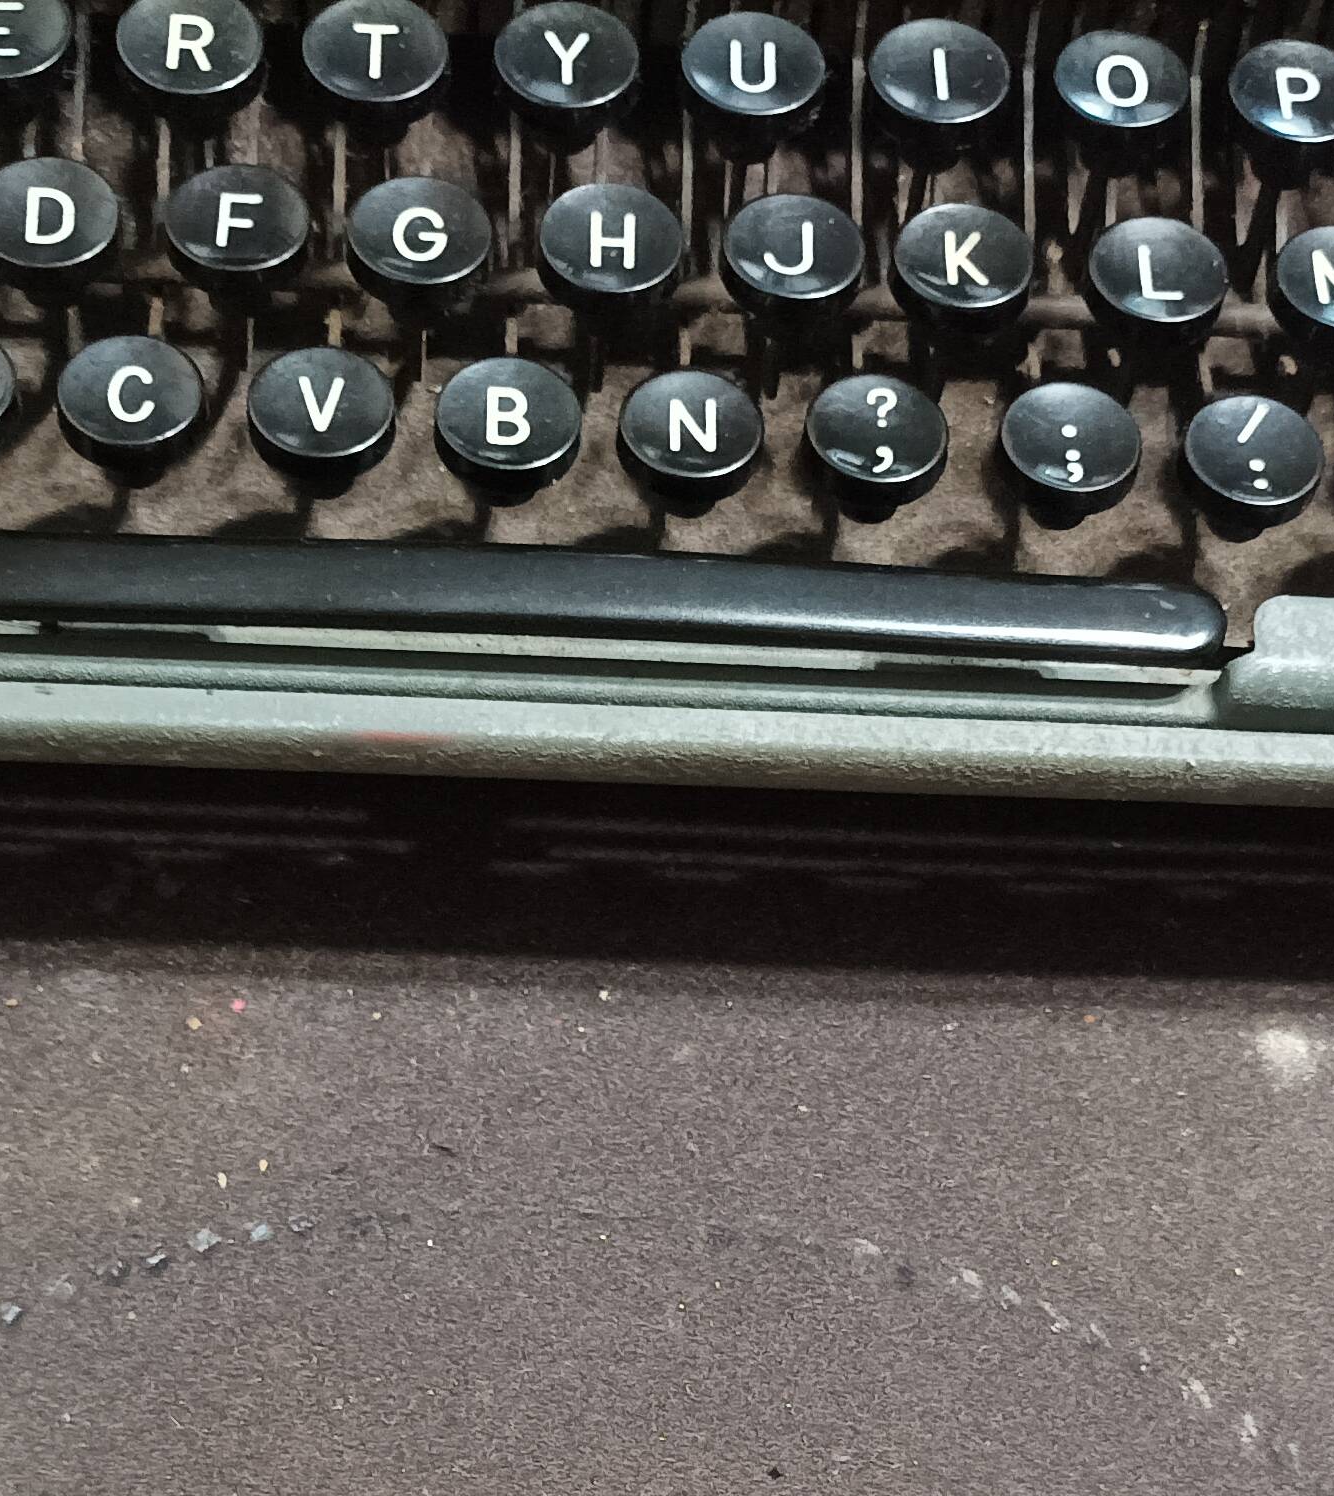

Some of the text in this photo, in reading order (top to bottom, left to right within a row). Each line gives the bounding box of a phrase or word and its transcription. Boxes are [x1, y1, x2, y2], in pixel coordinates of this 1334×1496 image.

[165, 13, 215, 72] R
[352, 22, 400, 80] T
[544, 30, 590, 85] Y
[730, 39, 777, 94] U
[933, 47, 949, 101] I
[1095, 54, 1149, 108] O
[1274, 67, 1322, 119] P
[24, 186, 76, 245] D
[215, 192, 263, 247] F
[392, 206, 448, 262] G
[589, 209, 636, 270] H
[763, 221, 814, 276] J
[944, 230, 989, 286] K
[1137, 242, 1184, 301] L
[106, 365, 155, 423] C
[298, 375, 345, 432] V
[485, 385, 531, 446] B
[866, 386, 898, 428] ?
[669, 397, 717, 453] N
